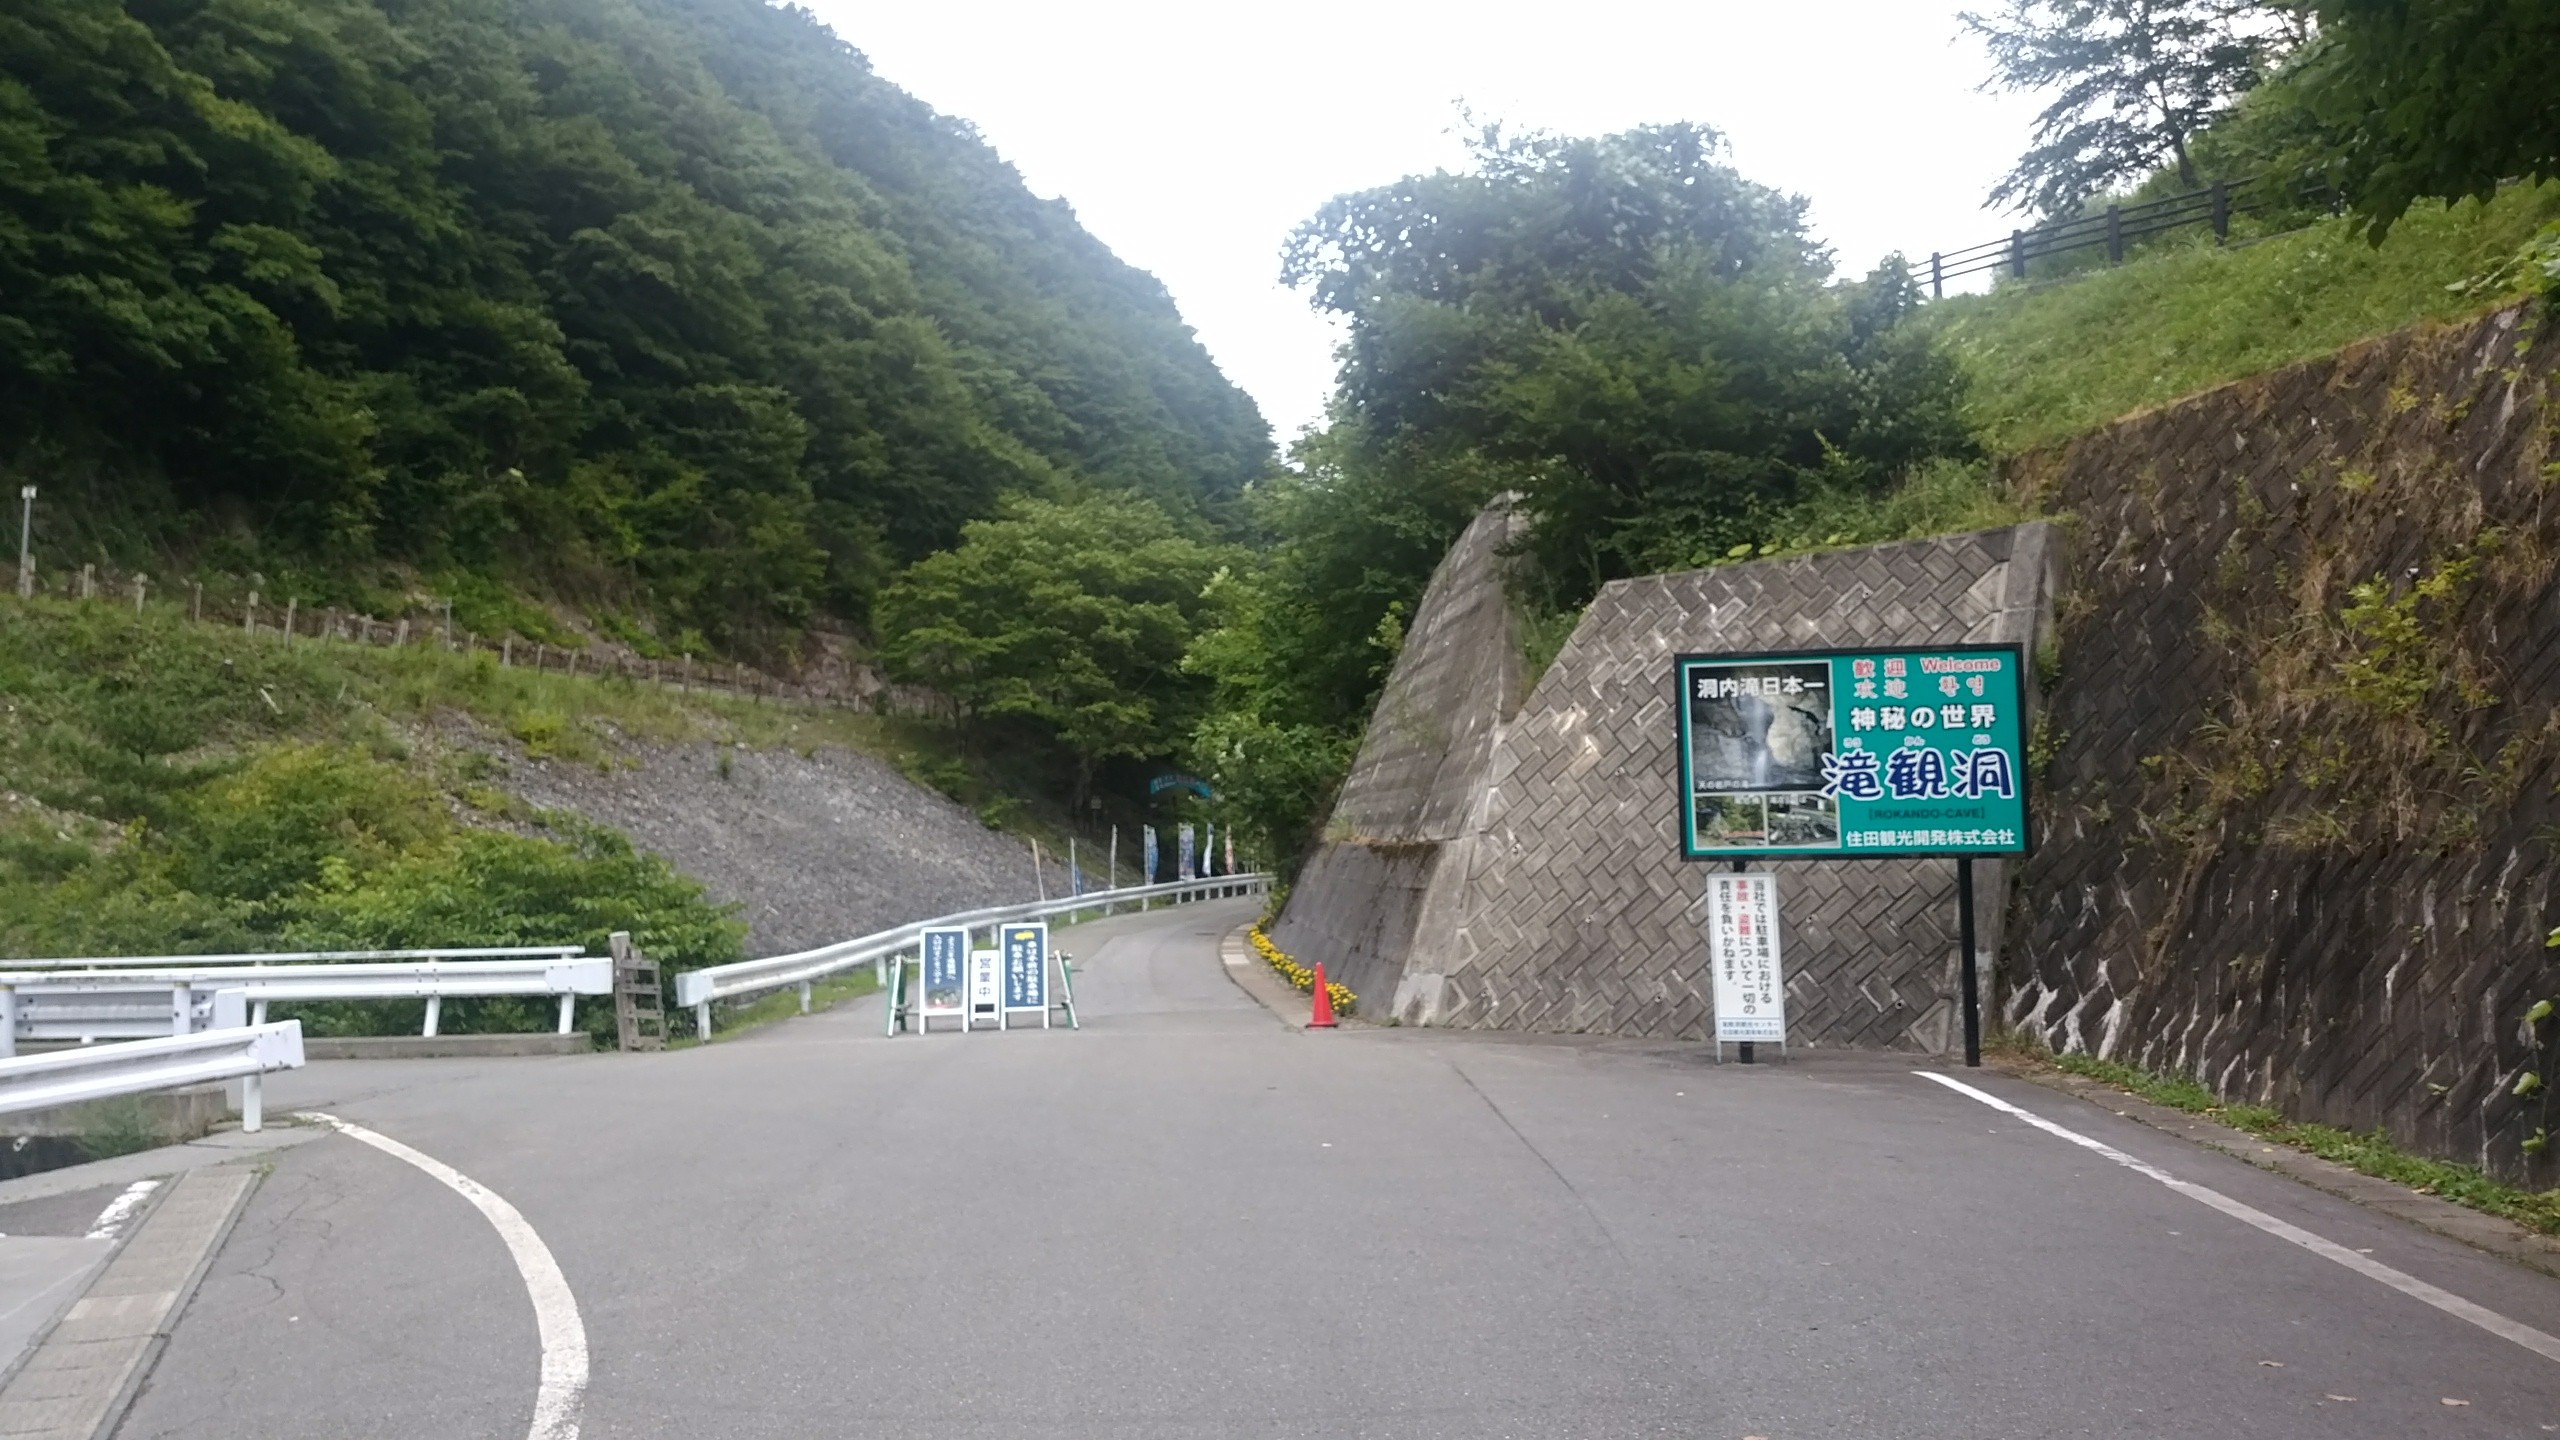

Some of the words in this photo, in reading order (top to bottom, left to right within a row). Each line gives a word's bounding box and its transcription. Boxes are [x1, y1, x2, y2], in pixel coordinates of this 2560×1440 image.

[1921, 656, 2001, 675] Welcome
[1697, 676, 1825, 699] 洞内滝日本一
[1850, 703, 1997, 733] 神秘の世界
[1820, 747, 2015, 800] 滝観洞
[1846, 829, 2015, 848] 住田観光開発株式会社
